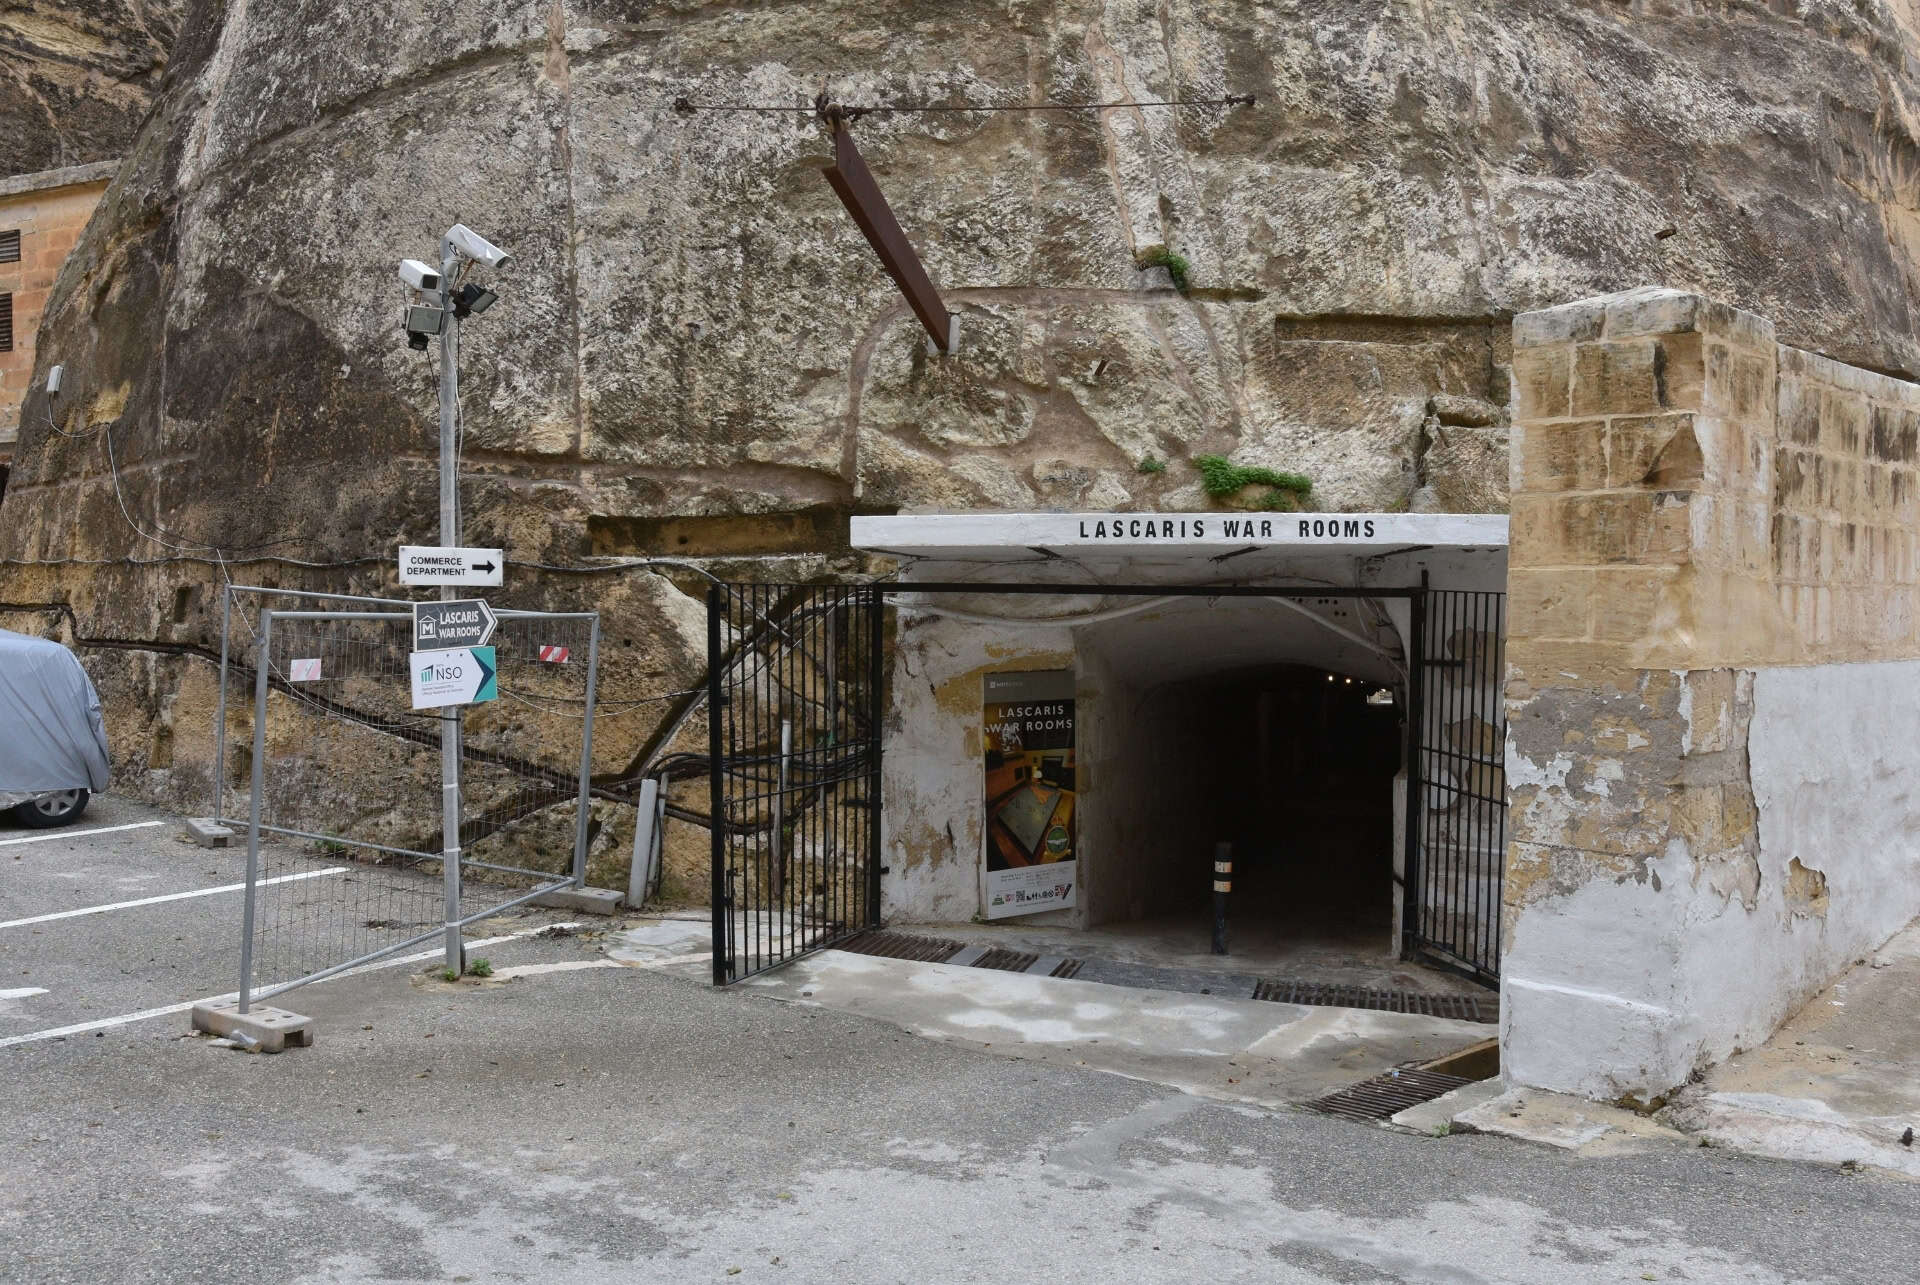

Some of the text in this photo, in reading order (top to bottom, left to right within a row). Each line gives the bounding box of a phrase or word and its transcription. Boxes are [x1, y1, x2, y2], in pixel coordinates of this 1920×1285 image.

[1079, 520, 1375, 538] LASCARIS WAR ROOMS
[410, 556, 462, 566] COMMERCE
[407, 567, 466, 576] DEPARTMENT
[440, 611, 479, 625] LASCARIS
[422, 622, 433, 635] M
[439, 626, 480, 639] WAR ROOMS
[436, 666, 462, 680] NSO
[999, 705, 1064, 718] LASCARIS
[990, 719, 1073, 733] WAR ROOMS
